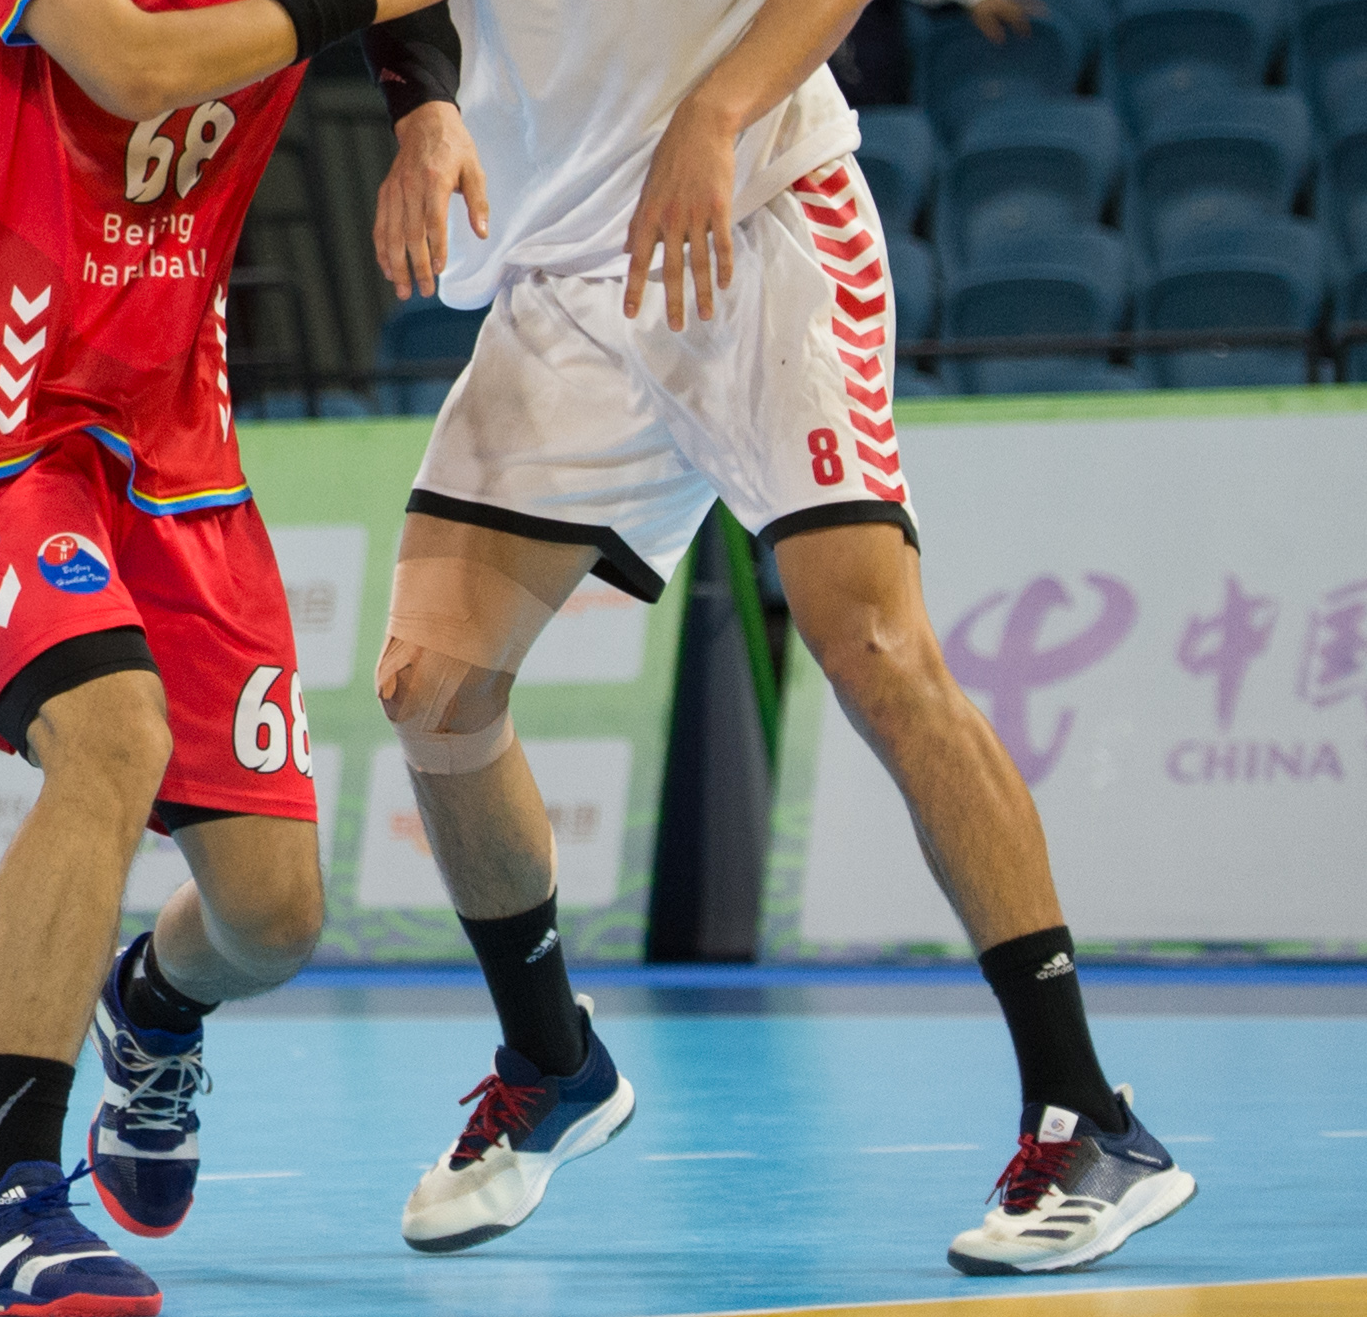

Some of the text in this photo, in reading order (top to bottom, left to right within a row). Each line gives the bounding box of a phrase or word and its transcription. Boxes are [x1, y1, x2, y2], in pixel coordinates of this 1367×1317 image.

[123, 99, 238, 204] 68
[808, 428, 845, 486] 8
[1173, 570, 1367, 730] 中国
[232, 664, 314, 778] 68
[1164, 738, 1347, 785] CHINA
